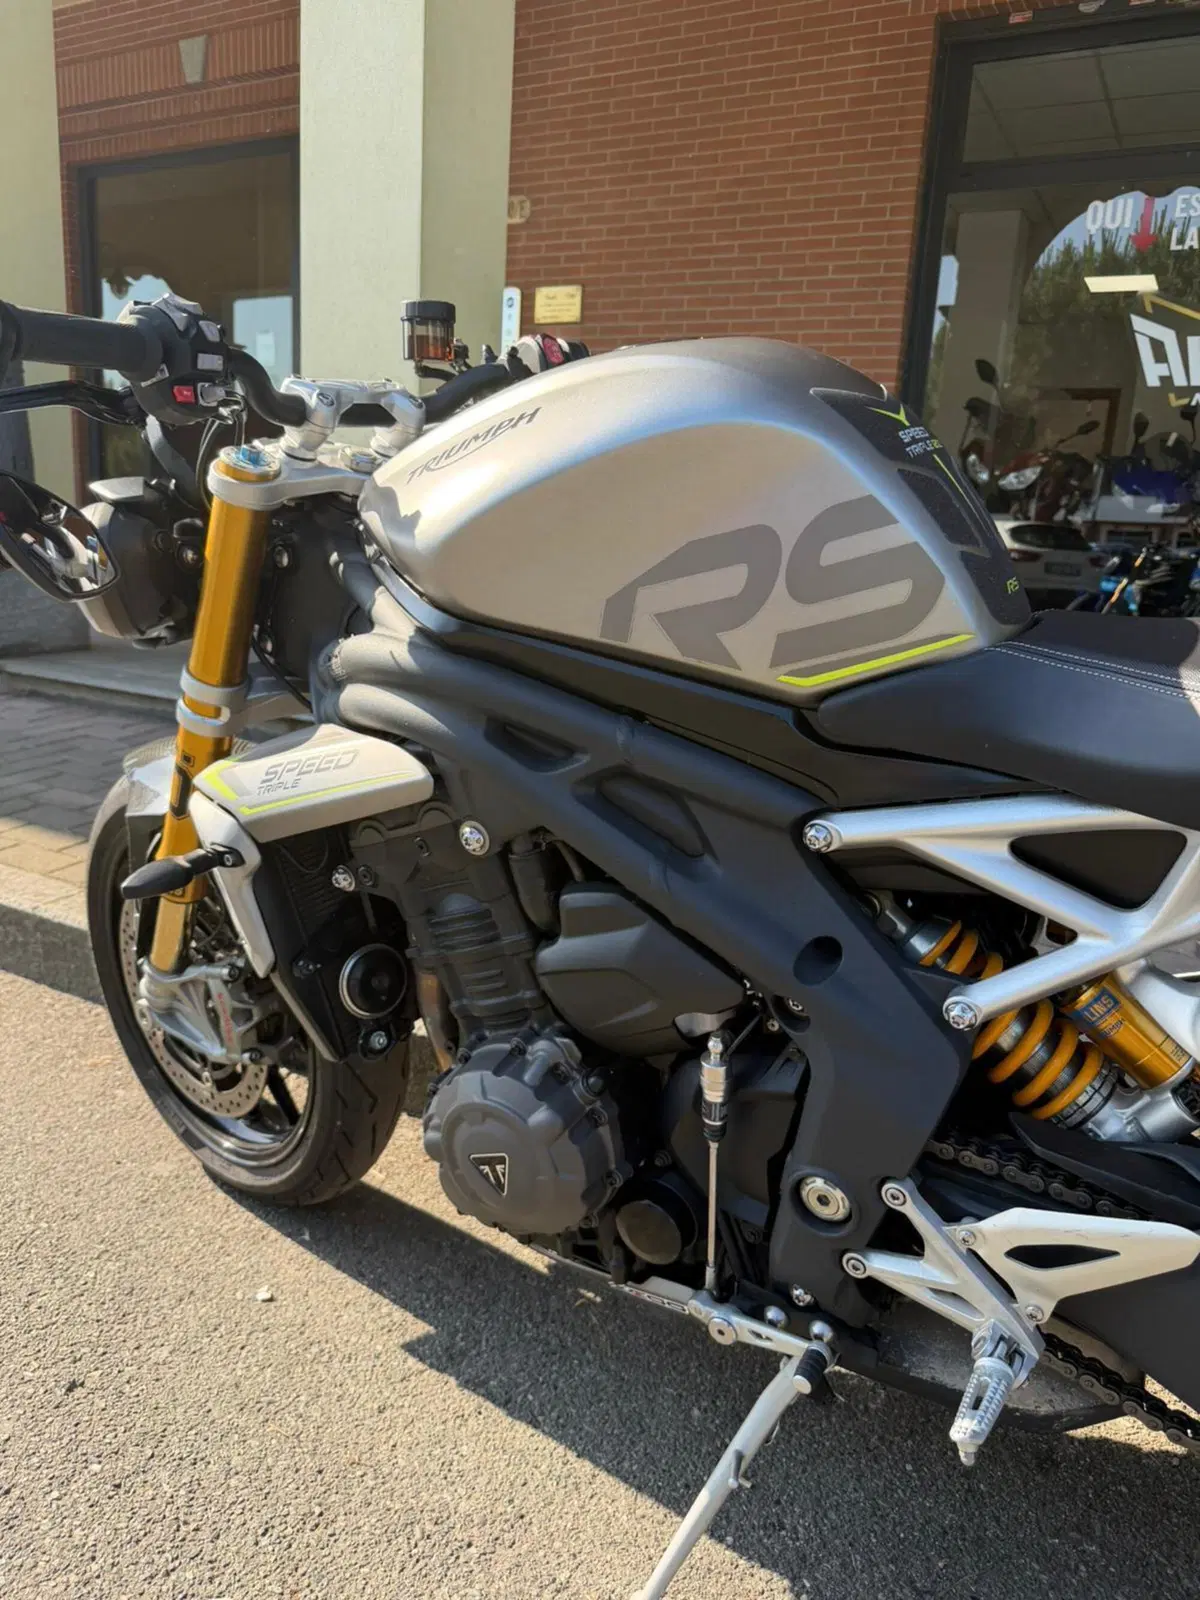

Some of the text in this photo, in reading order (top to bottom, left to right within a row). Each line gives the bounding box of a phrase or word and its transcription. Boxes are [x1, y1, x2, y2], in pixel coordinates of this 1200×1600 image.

[1086, 199, 1134, 235] QUI
[1129, 312, 1200, 387] A
[405, 406, 542, 485] TRIUMPH
[898, 426, 930, 443] SPEED
[600, 494, 946, 670] RS
[260, 748, 360, 785] SPEED
[257, 778, 302, 796] TRIPLE
[1083, 994, 1115, 1023] LINS
